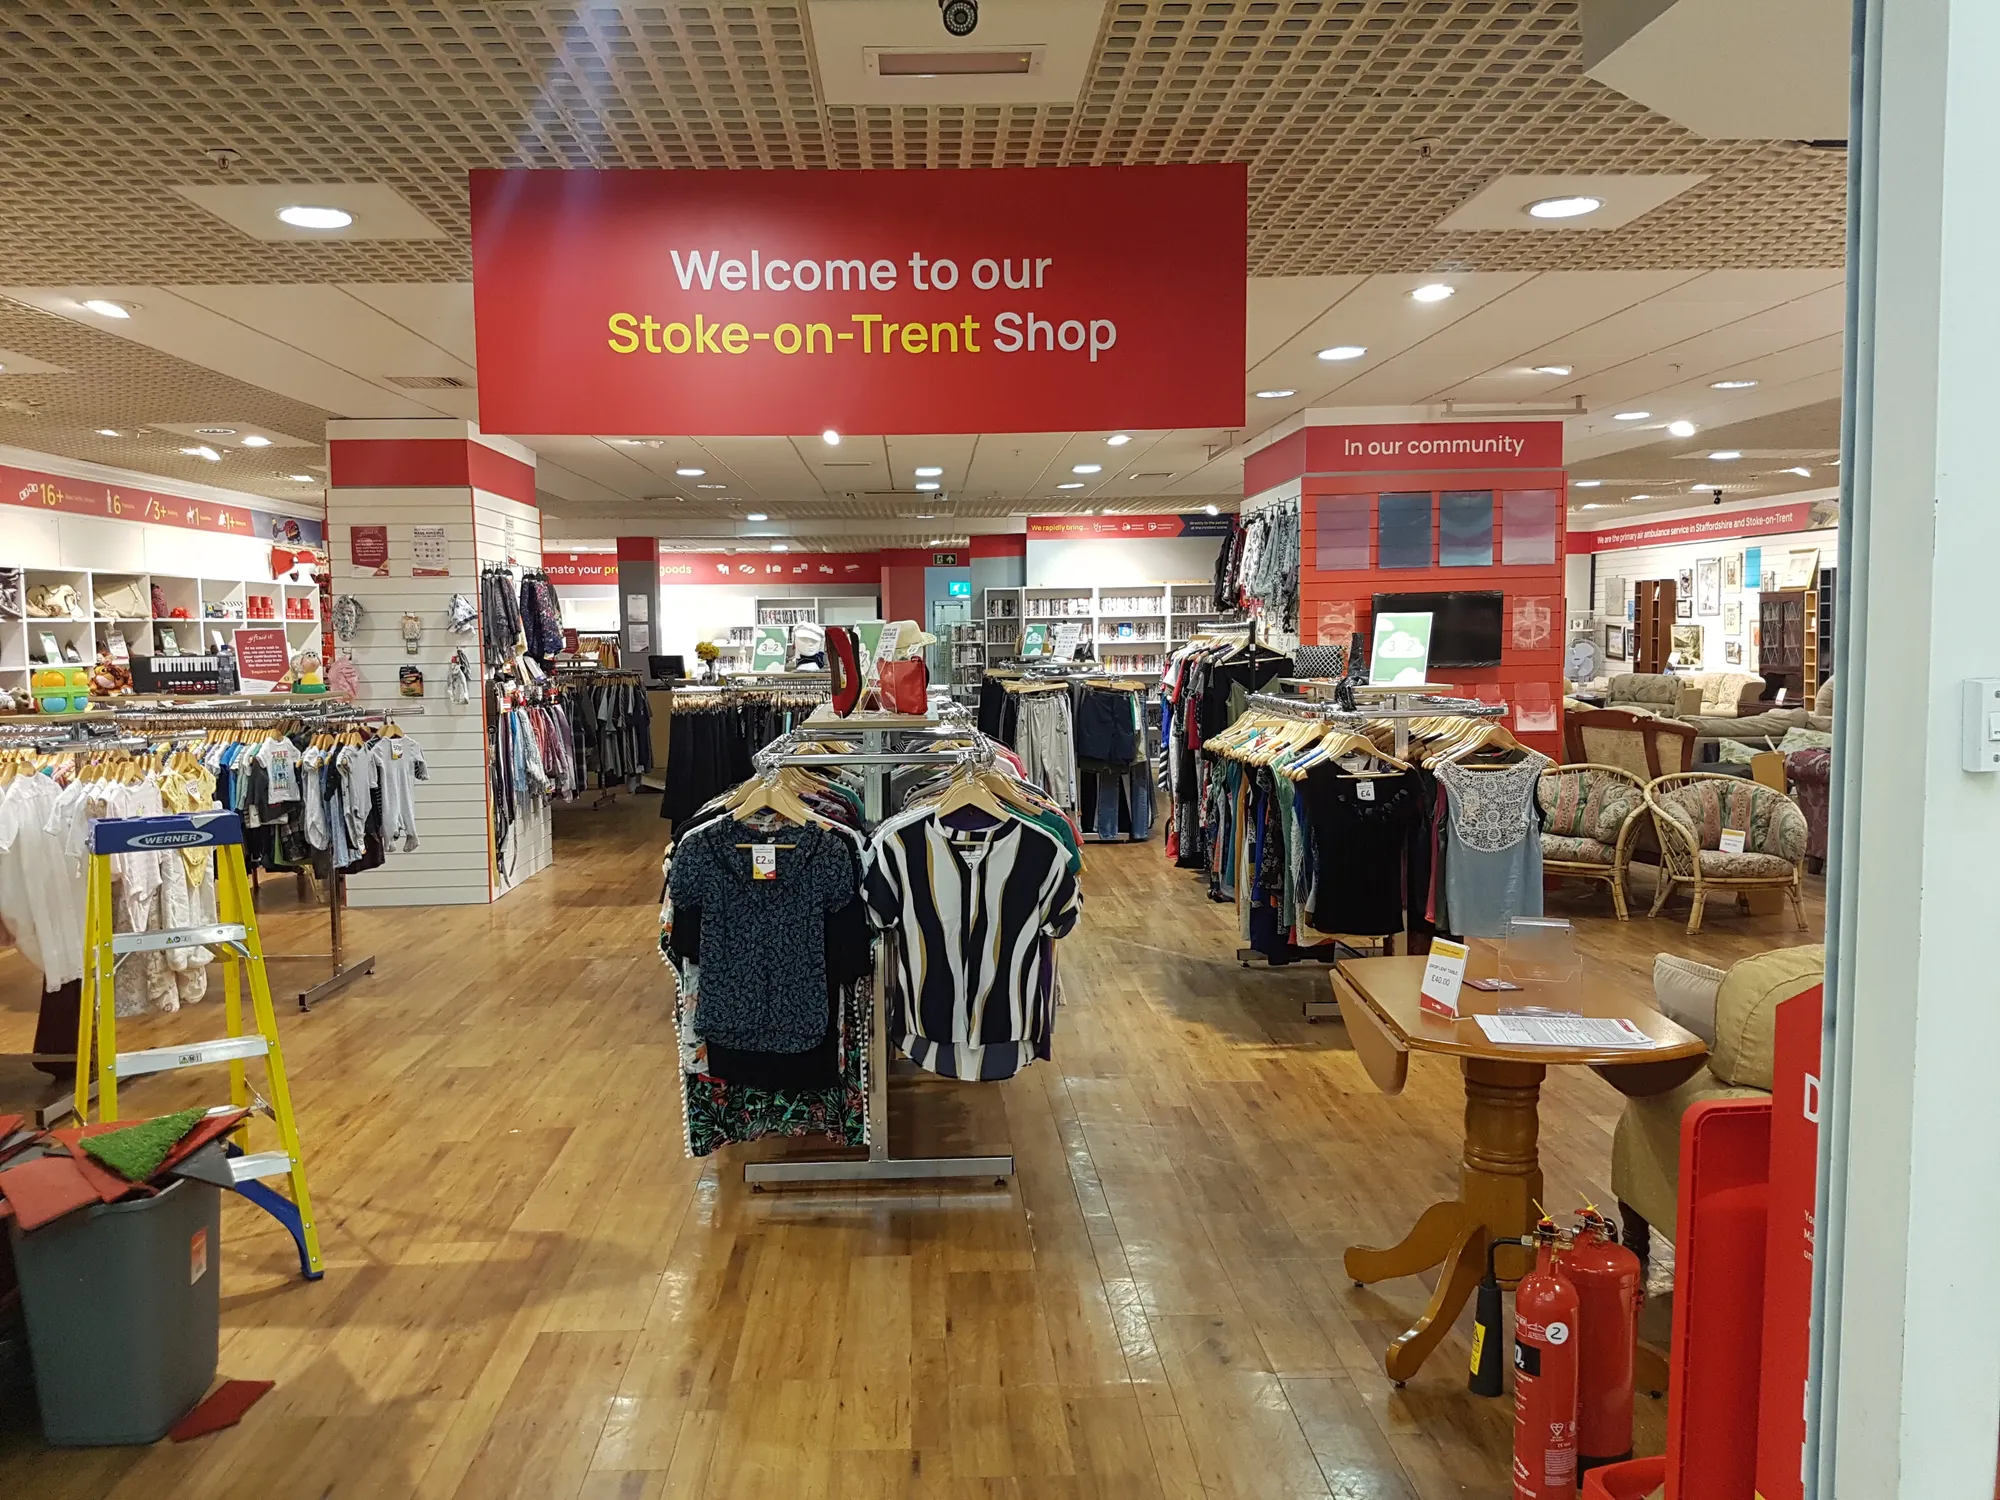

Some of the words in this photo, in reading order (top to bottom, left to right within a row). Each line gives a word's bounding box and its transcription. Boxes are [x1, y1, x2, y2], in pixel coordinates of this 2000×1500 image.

[669, 249, 898, 292] Welcome
[908, 251, 960, 291] to
[971, 257, 1053, 290] our
[606, 312, 981, 355] Stoke-on-Trent
[993, 311, 1118, 363] Shop
[1344, 438, 1363, 456] In
[1367, 441, 1403, 455] our
[1407, 435, 1525, 457] community
[39, 482, 65, 506] 16+
[113, 494, 122, 515] 6
[153, 500, 168, 521] 3+
[1042, 524, 1066, 532] rapidly
[1597, 536, 1604, 544] We
[1620, 532, 1637, 544] primary
[1644, 528, 1670, 539] ambulance
[1670, 526, 1688, 536] service
[1690, 524, 1696, 532] in
[1696, 521, 1732, 532] Staffordshire
[1734, 519, 1745, 528] and
[1746, 512, 1792, 526] Stoke-on-Trent
[543, 564, 576, 575] onate
[578, 566, 602, 577] your
[660, 564, 692, 576] goods
[1388, 640, 1396, 651] 3
[144, 834, 197, 844] WERNER
[1431, 975, 1450, 986] £40.00
[1550, 1327, 1562, 1340] 2
